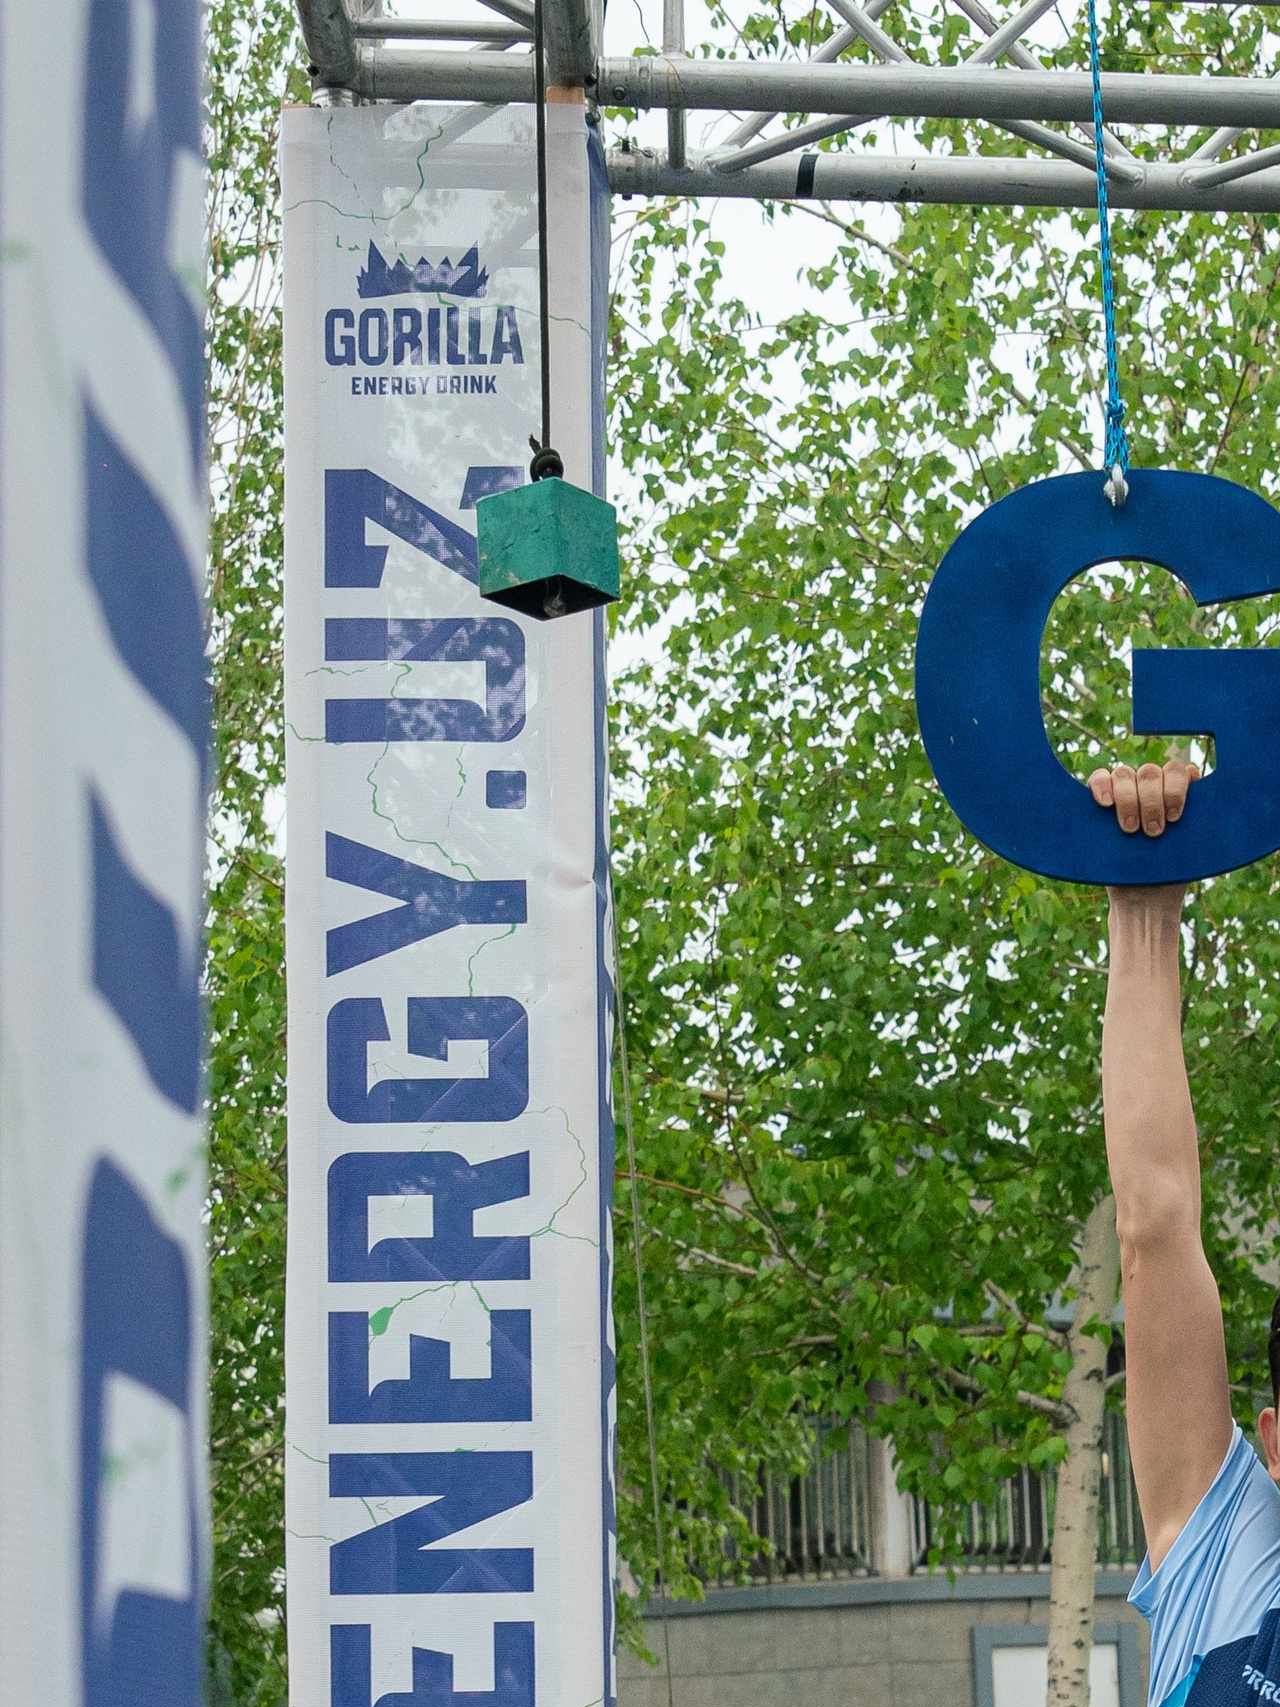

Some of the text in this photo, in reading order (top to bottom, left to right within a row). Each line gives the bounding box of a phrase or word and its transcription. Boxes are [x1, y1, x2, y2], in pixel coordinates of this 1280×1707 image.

[325, 305, 524, 366] GORILLA
[351, 375, 498, 396] ENERGY DRINK
